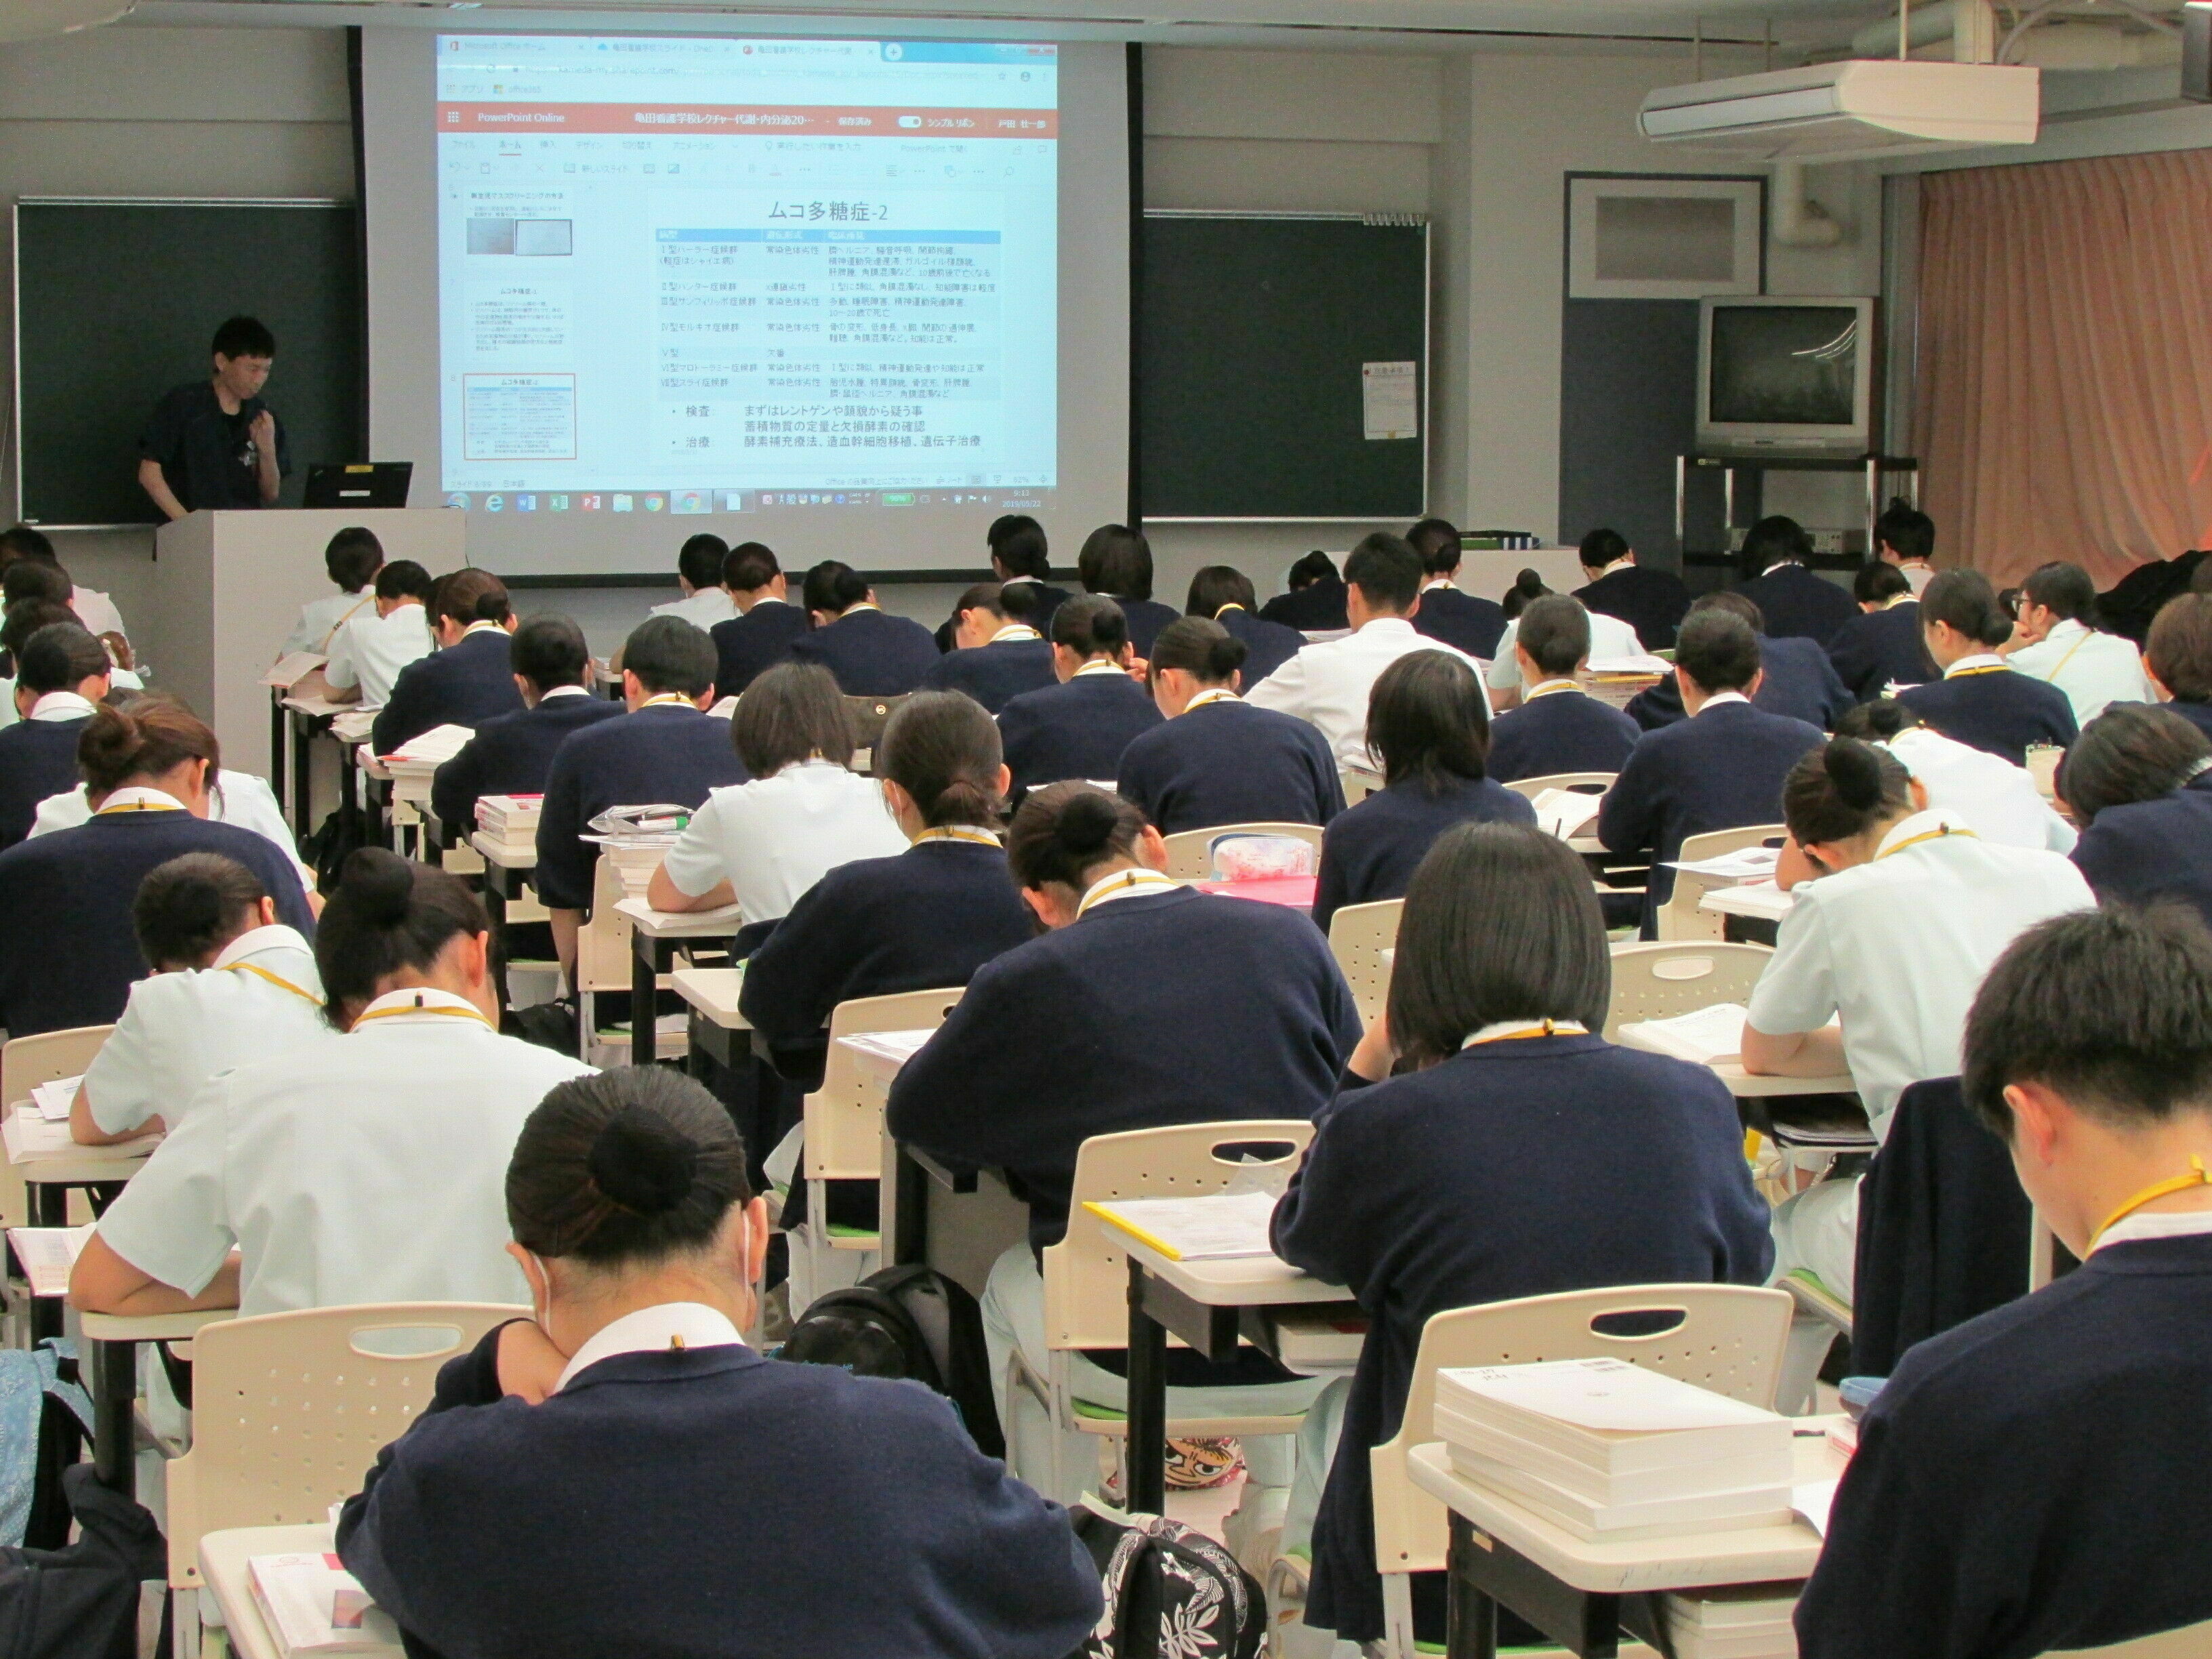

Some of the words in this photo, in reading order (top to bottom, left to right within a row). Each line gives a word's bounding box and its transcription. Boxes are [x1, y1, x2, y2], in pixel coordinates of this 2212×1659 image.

[478, 112, 531, 123] PowerPoint
[534, 113, 565, 123] Online
[928, 117, 954, 127] シンプル
[499, 140, 521, 148] ホーム
[901, 144, 947, 152] PowerPoint
[769, 201, 888, 221] ムコ多糖症-2
[766, 245, 819, 255] 常染色体劣性
[766, 297, 819, 306] 常染色体劣性
[767, 323, 820, 332] 常染色体劣性
[768, 363, 821, 372] 常染色体劣性
[768, 378, 821, 387] 常染色体劣性
[686, 405, 710, 417] 検査
[745, 405, 922, 417] まずはレントゲンや顔貌から疑う事
[745, 420, 926, 432] 蓄積物質の定量と欠損酵素の確認
[686, 436, 710, 448] 治療
